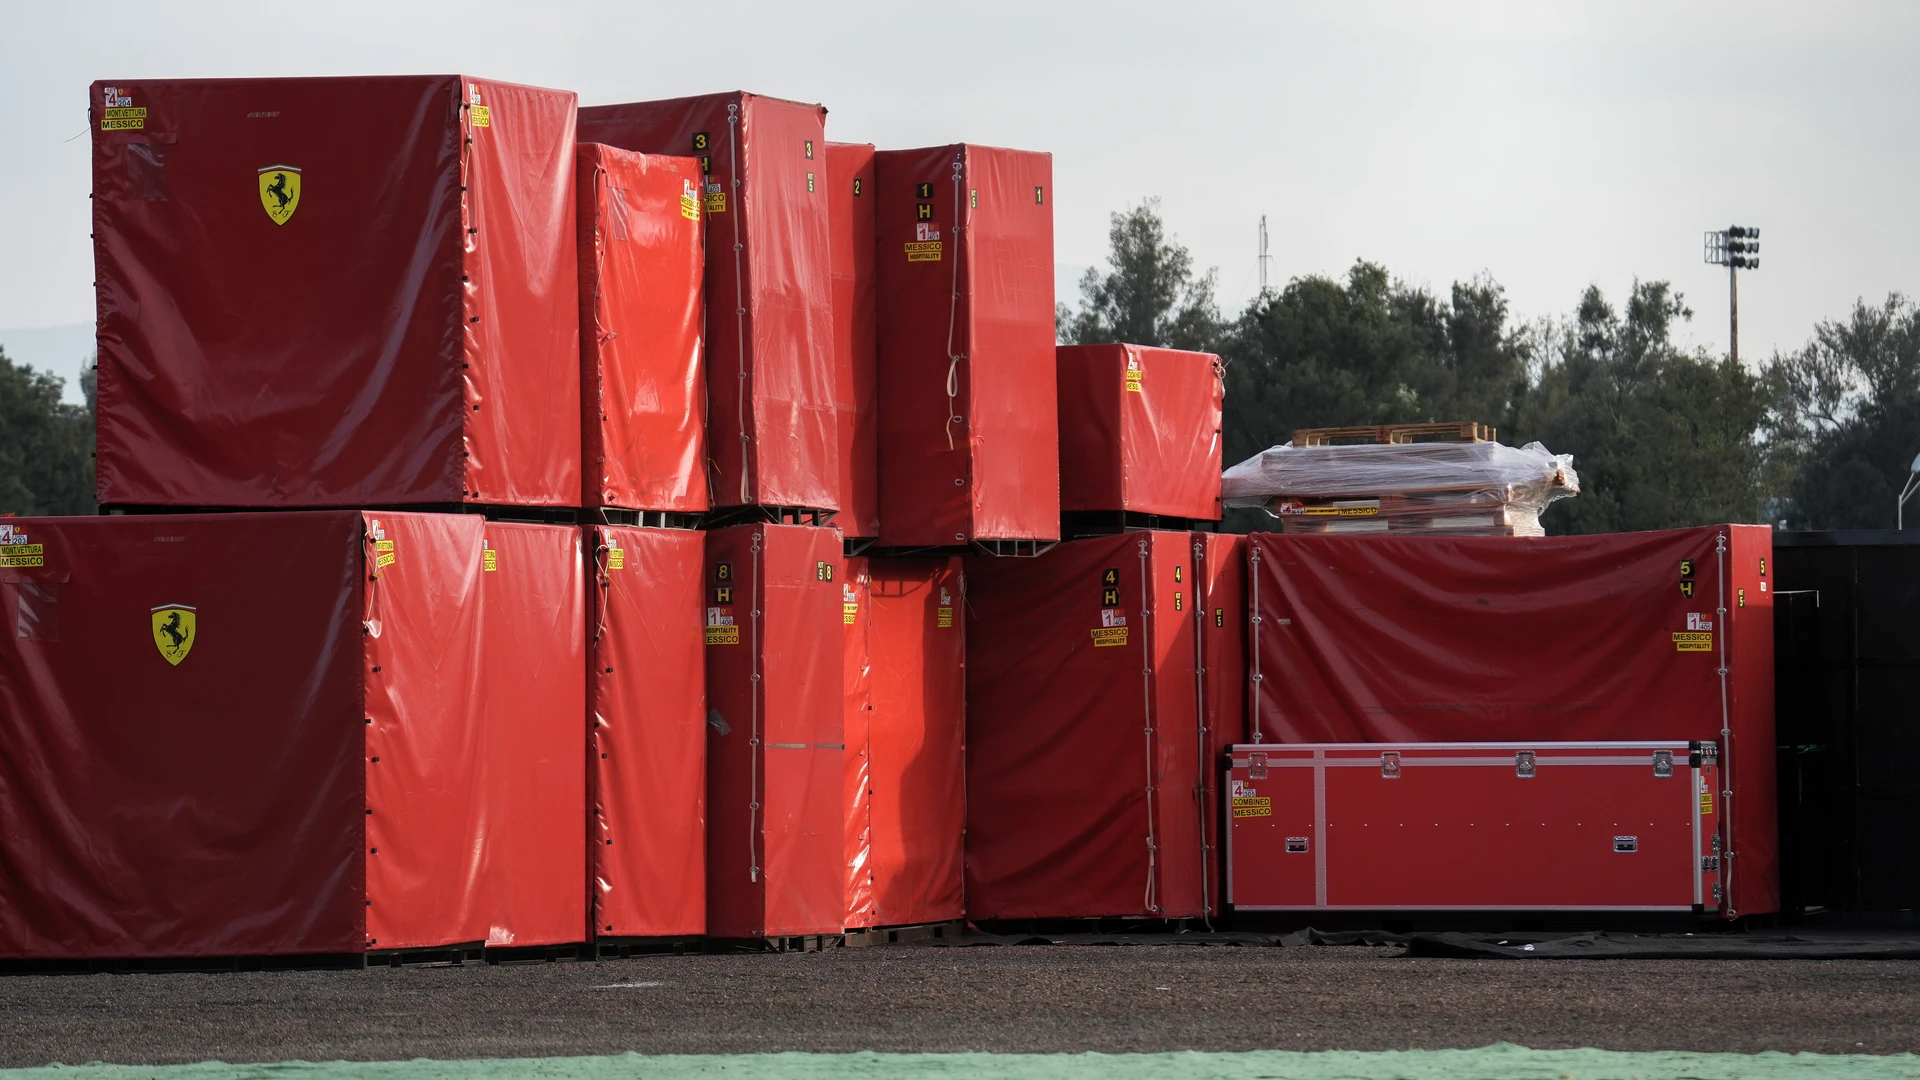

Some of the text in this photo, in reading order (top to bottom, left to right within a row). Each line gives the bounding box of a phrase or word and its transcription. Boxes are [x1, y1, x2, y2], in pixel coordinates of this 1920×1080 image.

[108, 94, 117, 106] 4
[102, 120, 144, 129] MESSICO
[696, 134, 707, 149] 3
[806, 142, 812, 157] 3
[808, 180, 814, 192] 5
[854, 180, 860, 194] 2
[922, 183, 929, 197] 1
[705, 194, 725, 203] SICO
[972, 197, 977, 208] 5
[918, 204, 931, 219] H
[920, 228, 926, 240] 1
[905, 242, 942, 251] MESSICO
[909, 252, 940, 260] HOSPITALITY
[1341, 506, 1379, 515] MESSICO
[2, 531, 11, 544] 4
[13, 537, 27, 545] 203
[1, 557, 43, 566] MESSICO
[1760, 560, 1765, 574] 5
[718, 564, 728, 579] 8
[826, 565, 832, 580] 8
[1175, 567, 1181, 581] 4
[1681, 561, 1691, 575] 5
[818, 569, 824, 580] 5
[1106, 570, 1115, 584] 4
[717, 587, 730, 602] H
[1105, 591, 1117, 605] H
[1176, 599, 1181, 610] 5
[710, 613, 717, 625] 1
[1105, 614, 1111, 626] 1
[1217, 616, 1222, 627] 5
[1690, 618, 1697, 630] 1
[1092, 628, 1128, 637] MESSICO
[1673, 633, 1712, 641] MESSICO
[707, 635, 739, 644] ESSICO
[1235, 785, 1243, 797] 4
[1233, 798, 1270, 806] COMBINED
[1234, 807, 1271, 817] MESSICO
